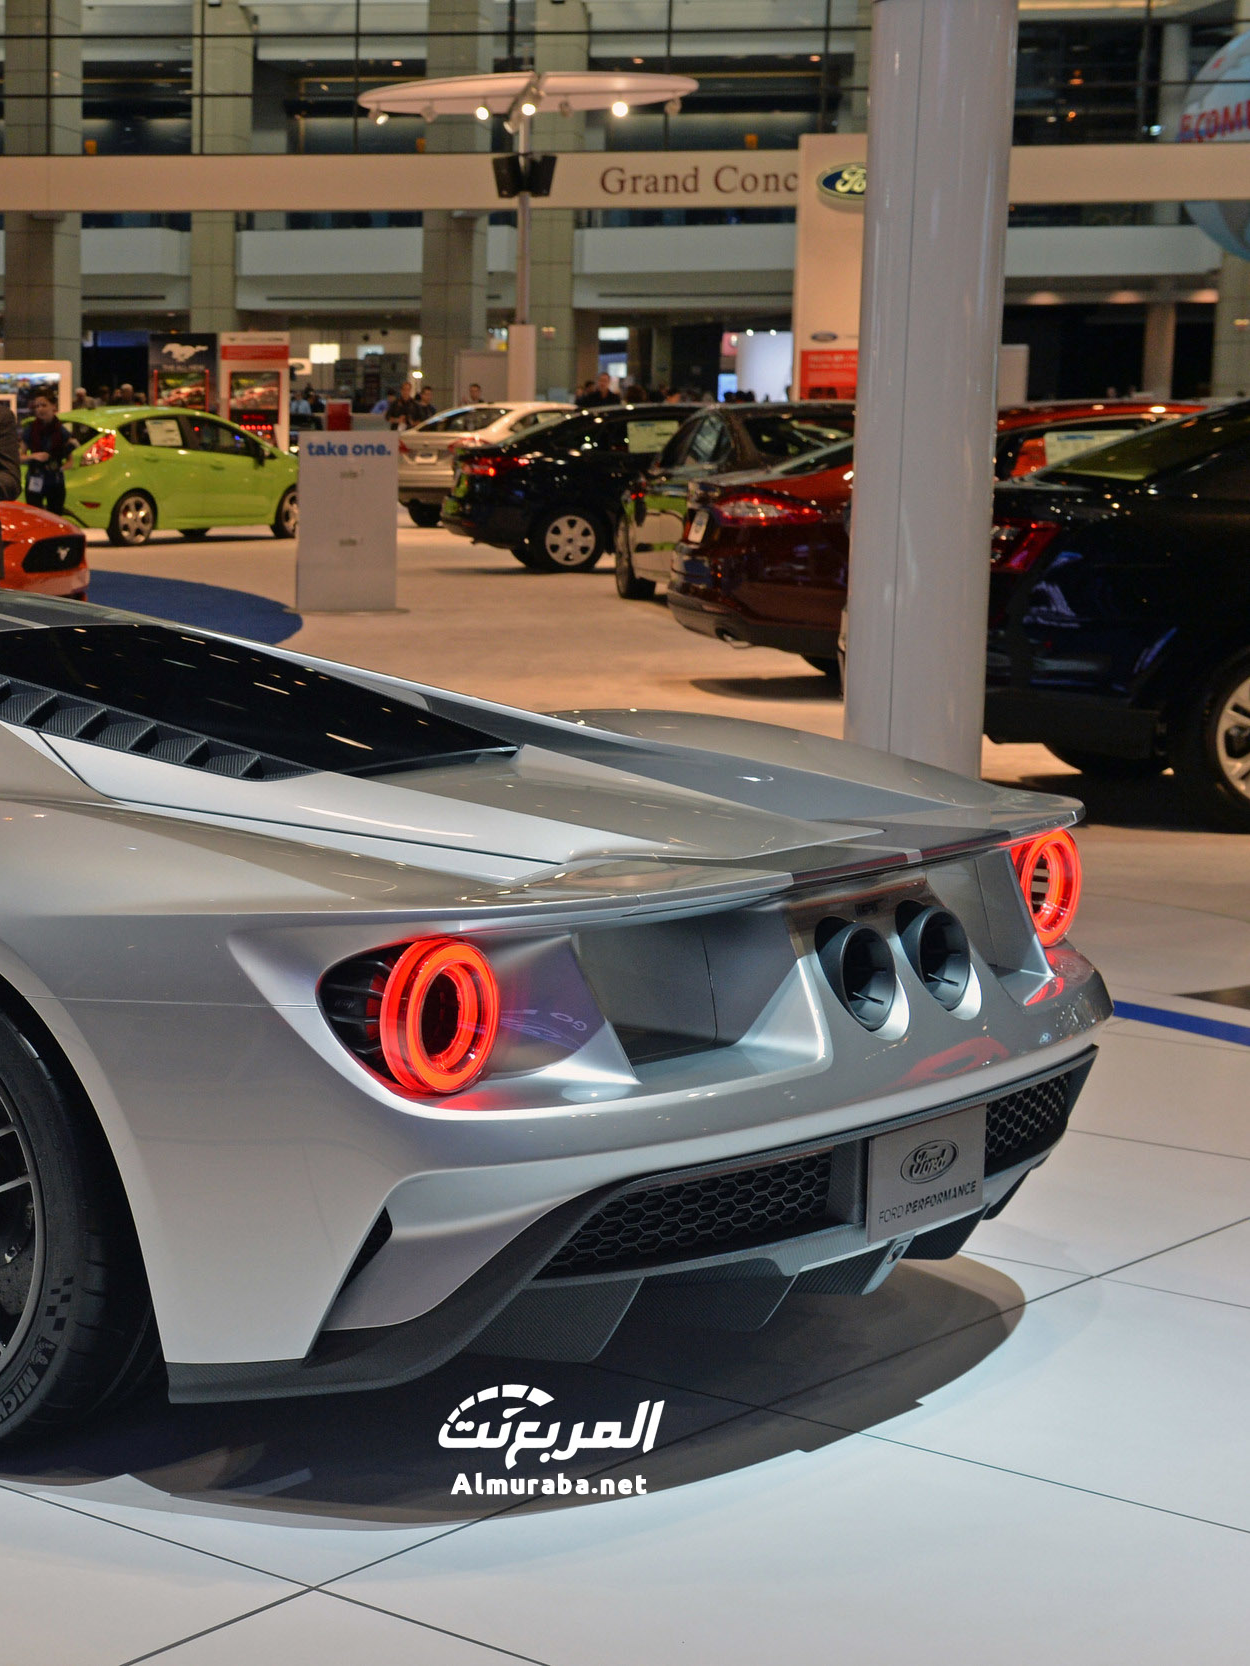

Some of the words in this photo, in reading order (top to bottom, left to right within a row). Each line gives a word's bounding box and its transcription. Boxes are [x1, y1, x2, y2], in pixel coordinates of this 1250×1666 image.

[600, 166, 699, 195] Grand
[713, 165, 798, 194] Conc
[835, 167, 866, 193] Fo
[307, 441, 348, 456] take
[352, 444, 391, 456] one.
[910, 1145, 947, 1178] Ford
[879, 1203, 905, 1224] FORD
[905, 1180, 977, 1215] PERFORMANCE
